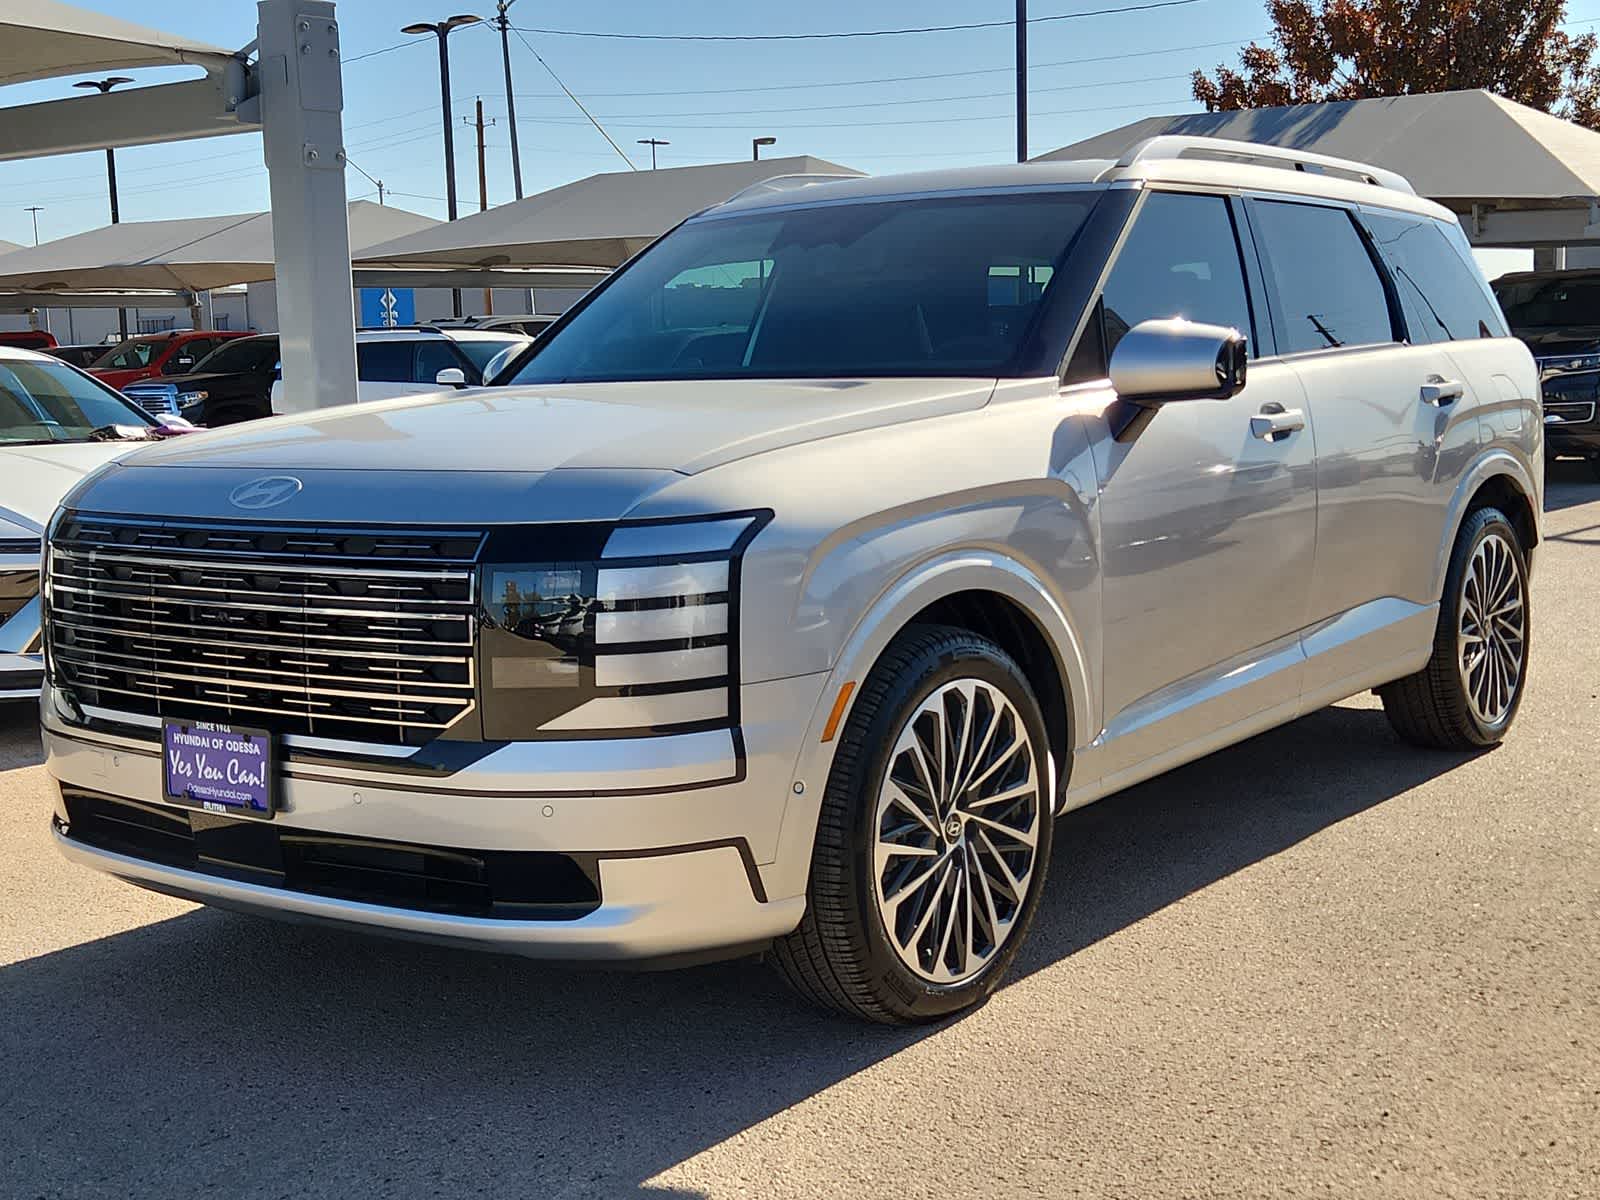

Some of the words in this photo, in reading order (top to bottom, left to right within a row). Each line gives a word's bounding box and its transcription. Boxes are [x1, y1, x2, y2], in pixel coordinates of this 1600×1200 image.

[195, 721, 215, 732] SINCE
[173, 733, 210, 748] HYUNDAI
[212, 738, 224, 750] OF
[225, 741, 261, 755] ODESSA
[169, 749, 193, 777] Yes
[195, 753, 224, 780] You
[226, 758, 266, 788] Can!
